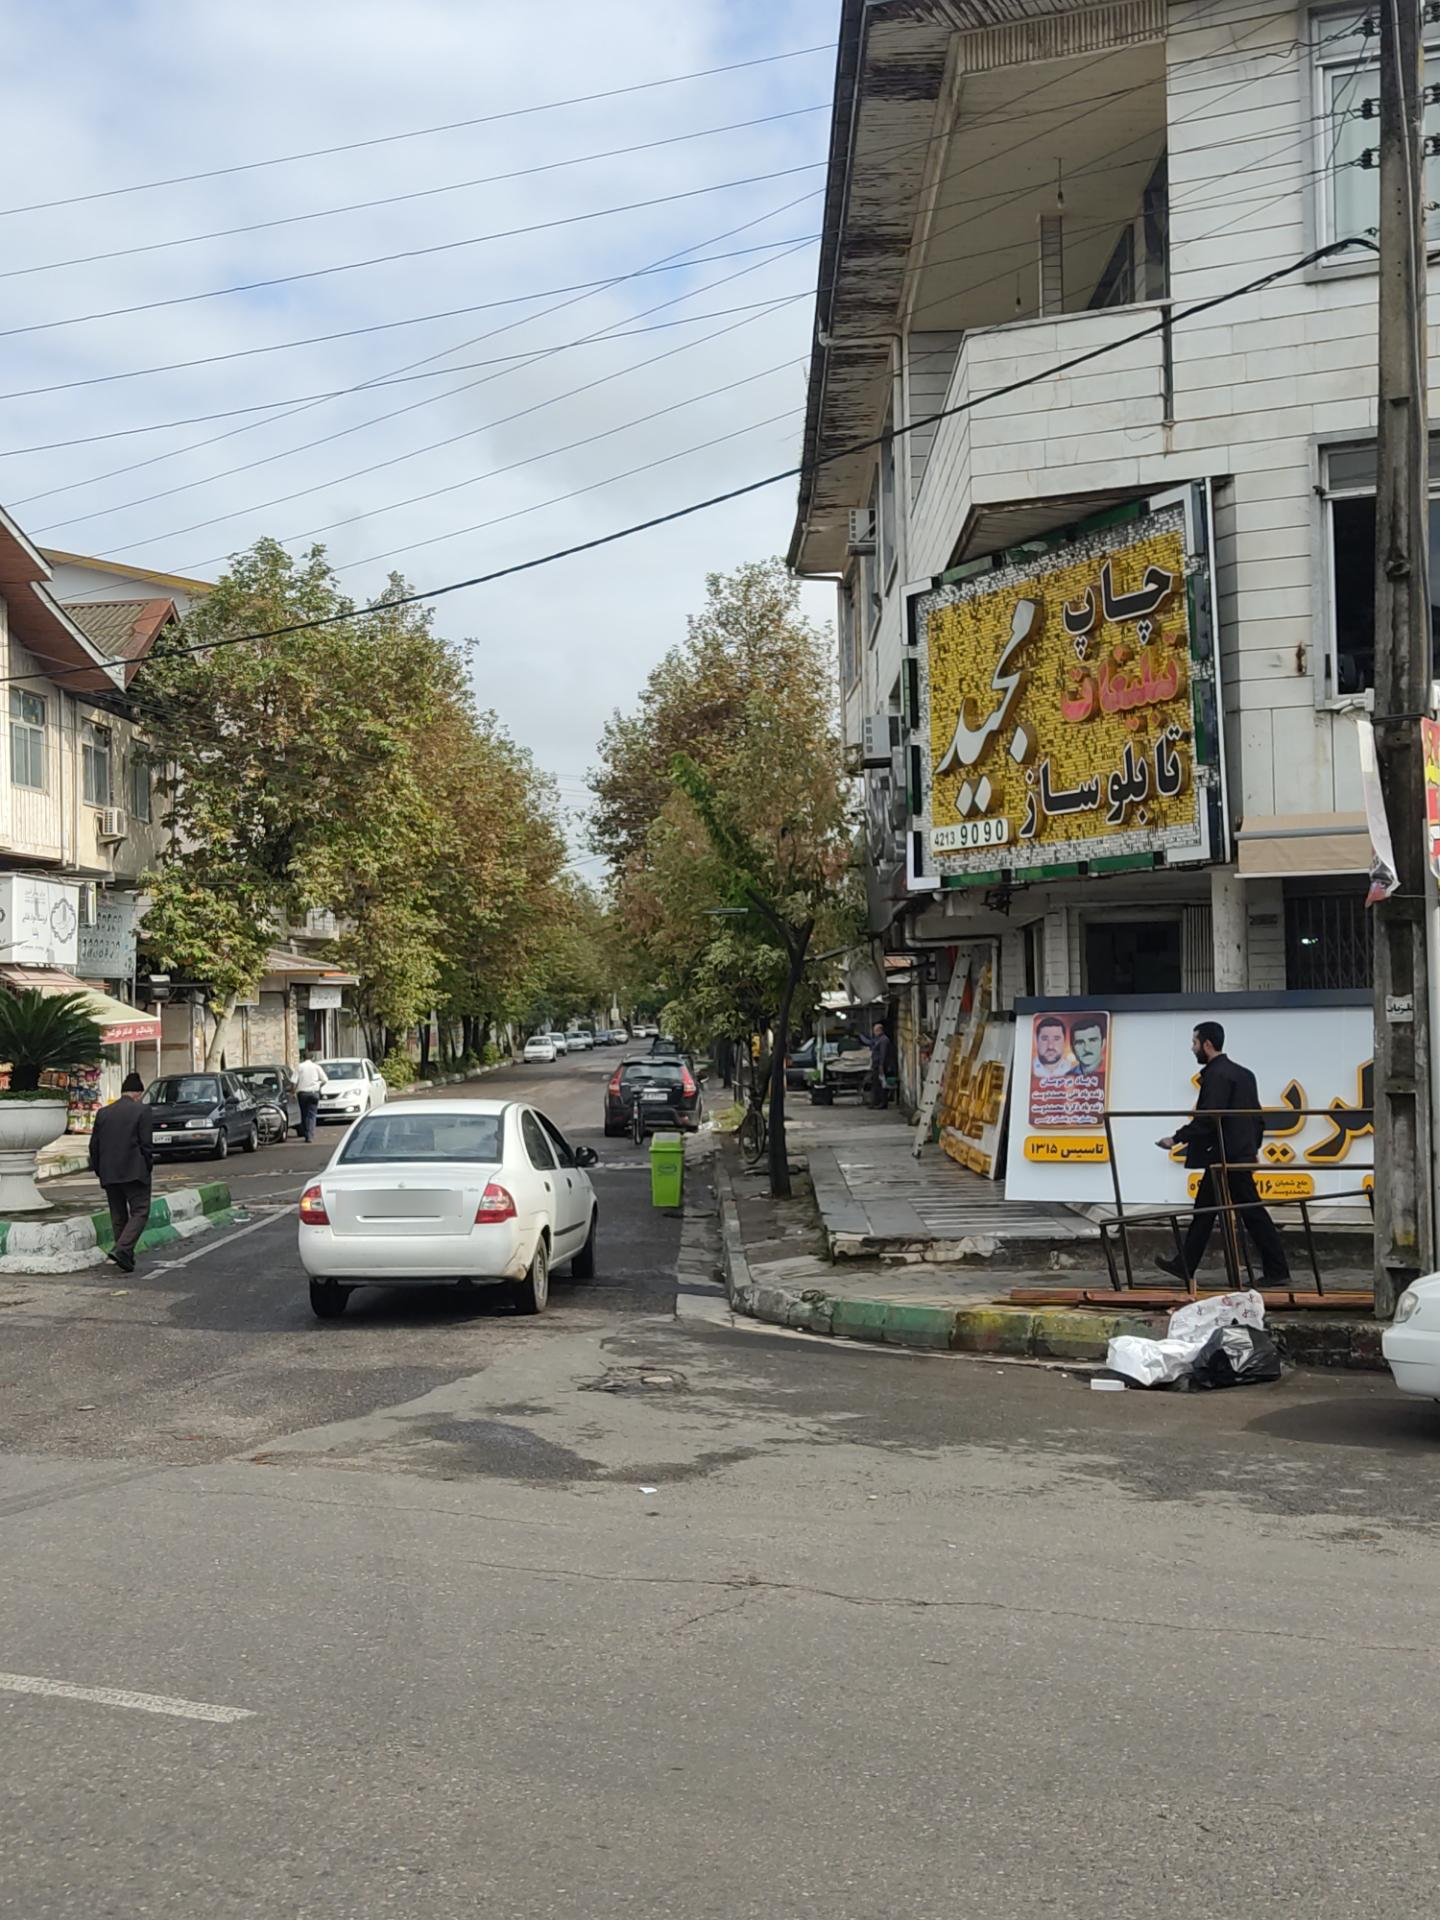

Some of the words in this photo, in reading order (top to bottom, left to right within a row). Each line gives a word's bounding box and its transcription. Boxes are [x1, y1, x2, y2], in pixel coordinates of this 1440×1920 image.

[1062, 558, 1176, 660] چاپ
[1060, 631, 1184, 731] تبلیغات
[934, 831, 956, 846] 4213
[960, 819, 1004, 846] 9090
[1031, 1143, 1058, 1154] ۱۳۱۵
[1060, 1143, 1104, 1158] تاسیس
